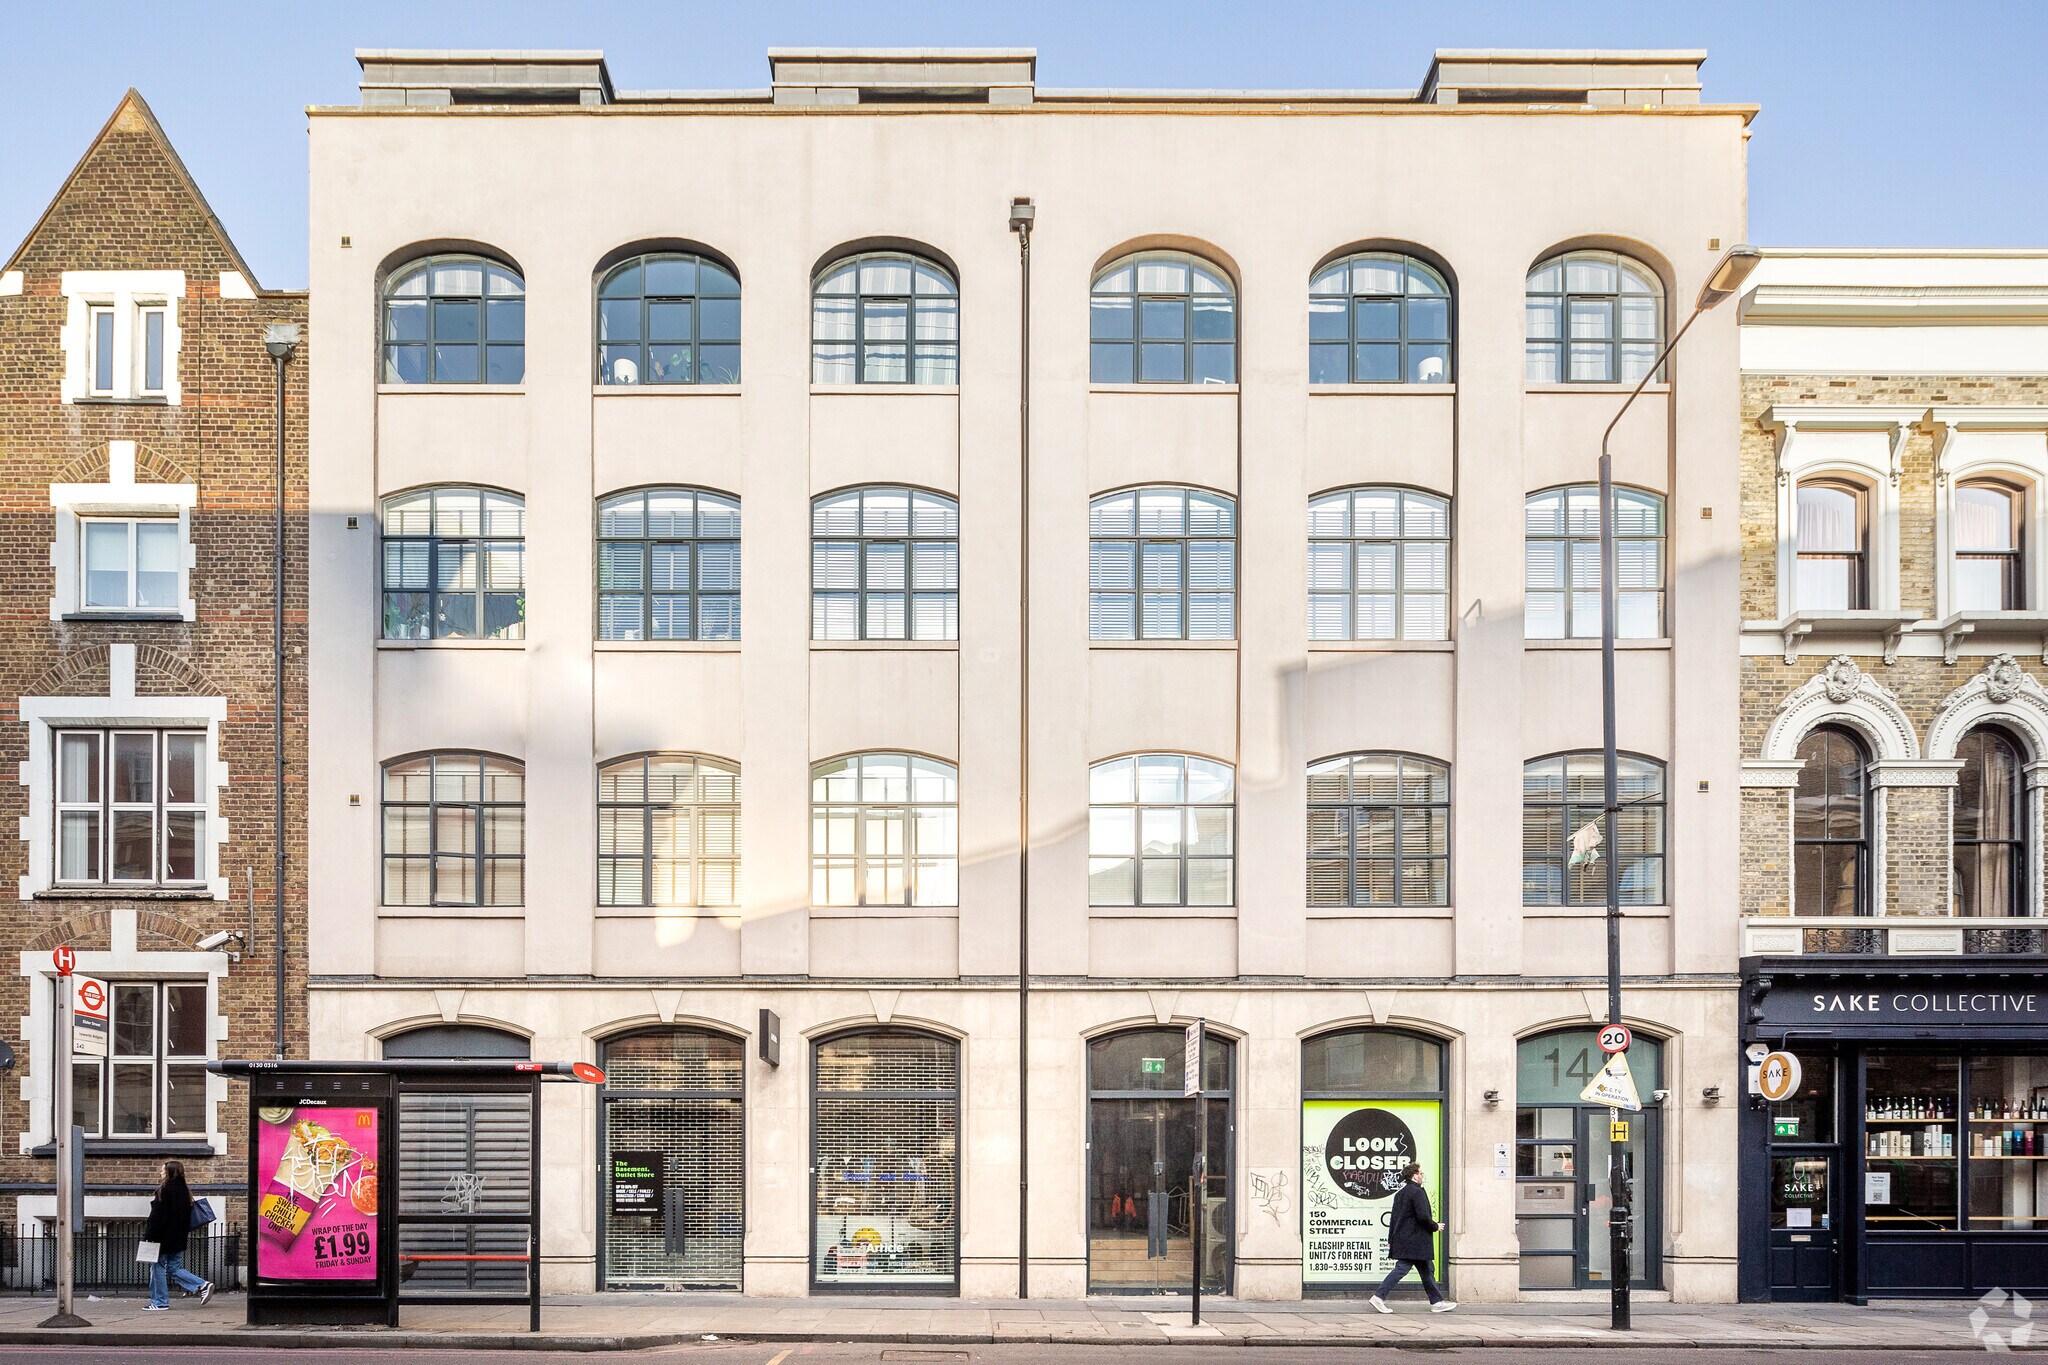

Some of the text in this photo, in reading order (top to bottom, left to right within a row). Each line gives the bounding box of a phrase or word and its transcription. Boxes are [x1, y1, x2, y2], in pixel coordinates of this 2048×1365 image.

[58, 948, 72, 969] H
[1812, 994, 2036, 1012] SAKE COLLECTIVE
[1602, 1032, 1625, 1045] 20
[1544, 1048, 1610, 1087] 14
[1762, 1068, 1788, 1079] SAKE
[1601, 1092, 1629, 1102] OPERATION
[1612, 1124, 1626, 1139] H
[1343, 1137, 1399, 1151] LOOK
[1330, 1156, 1411, 1170] CLOSER
[276, 1197, 300, 1213] SWEET
[272, 1205, 296, 1220] CHILLI
[264, 1210, 295, 1231] CHICKEN
[268, 1221, 282, 1234] ONE
[312, 1222, 368, 1235] WRAP OF THE DAY
[314, 1232, 370, 1260] £1.99
[1310, 1241, 1344, 1250] FLAGSHIP
[1347, 1241, 1371, 1250] RETAIL
[316, 1256, 371, 1269] FRIDAY & SUNDAY
[1310, 1252, 1372, 1260] UNIT/S FOR RENT
[1354, 1263, 1363, 1272] SQ
[1365, 1263, 1372, 1271] FT
